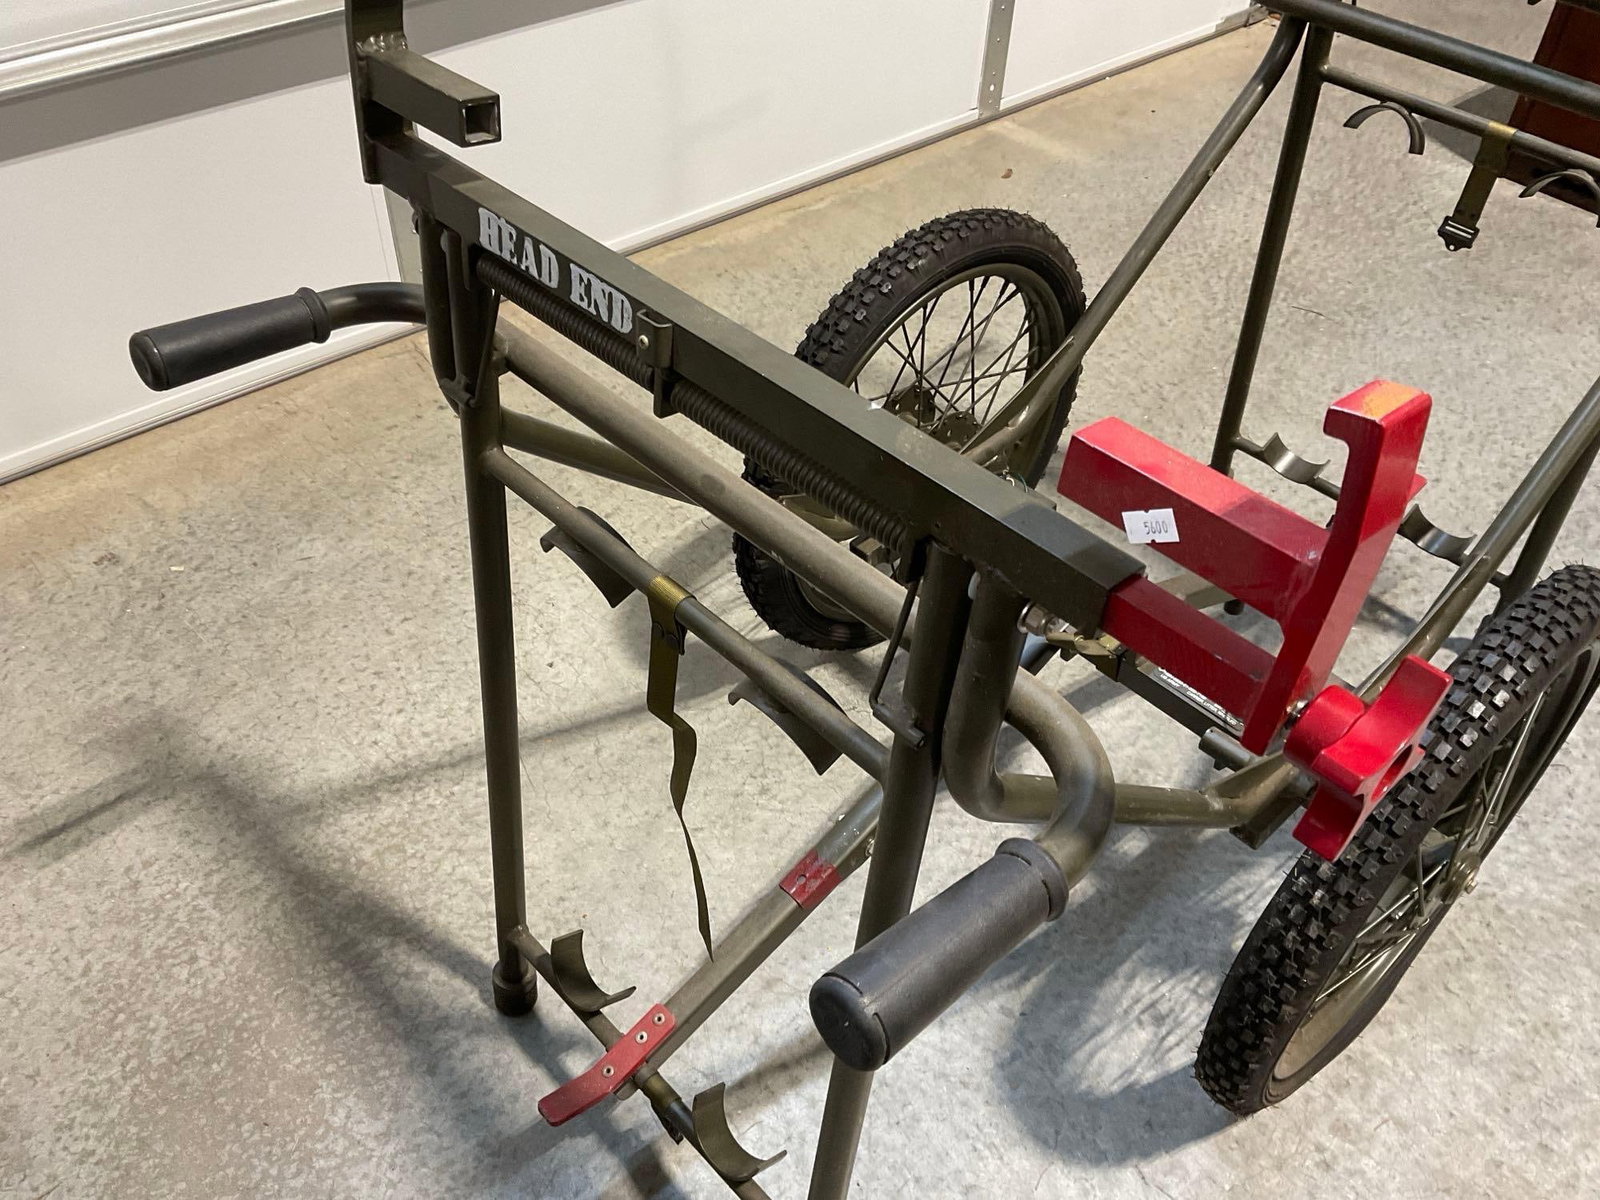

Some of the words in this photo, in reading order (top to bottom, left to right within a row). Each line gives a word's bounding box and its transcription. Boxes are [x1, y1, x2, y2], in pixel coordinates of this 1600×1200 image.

[478, 207, 559, 288] HEAD
[569, 263, 633, 333] END
[1143, 520, 1168, 535] 5600
